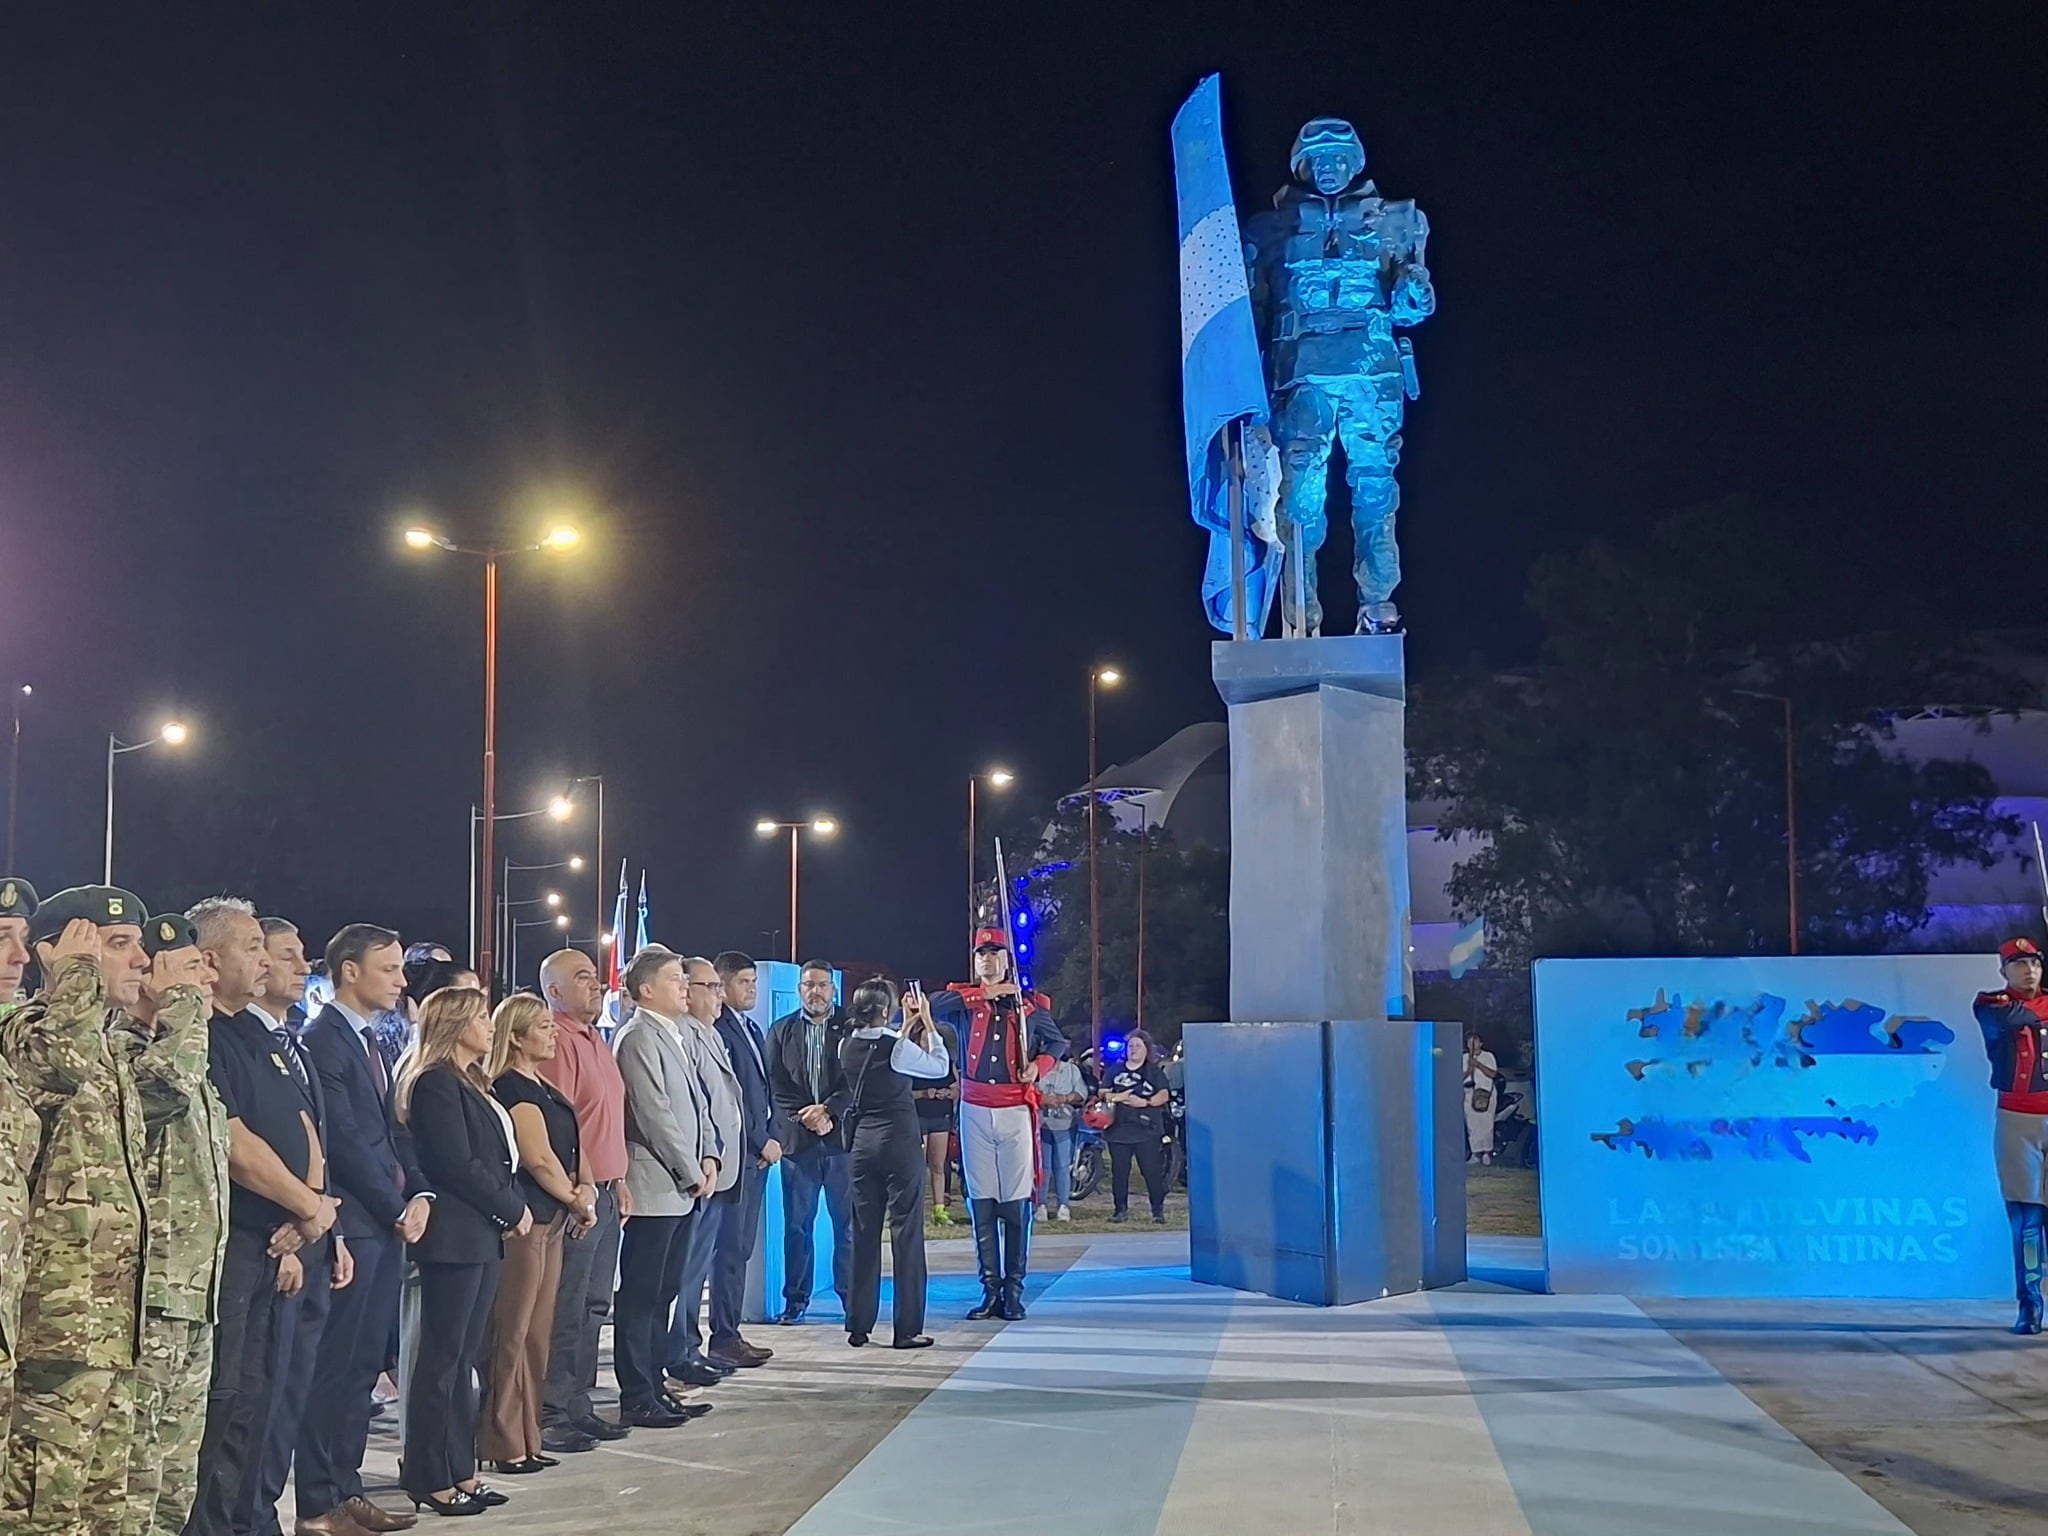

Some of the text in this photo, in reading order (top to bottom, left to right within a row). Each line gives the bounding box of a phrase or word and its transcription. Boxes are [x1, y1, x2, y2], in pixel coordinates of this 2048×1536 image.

[1608, 1197, 1969, 1228] LA LVINAS
[1700, 1233, 1960, 1264] NTINAS
